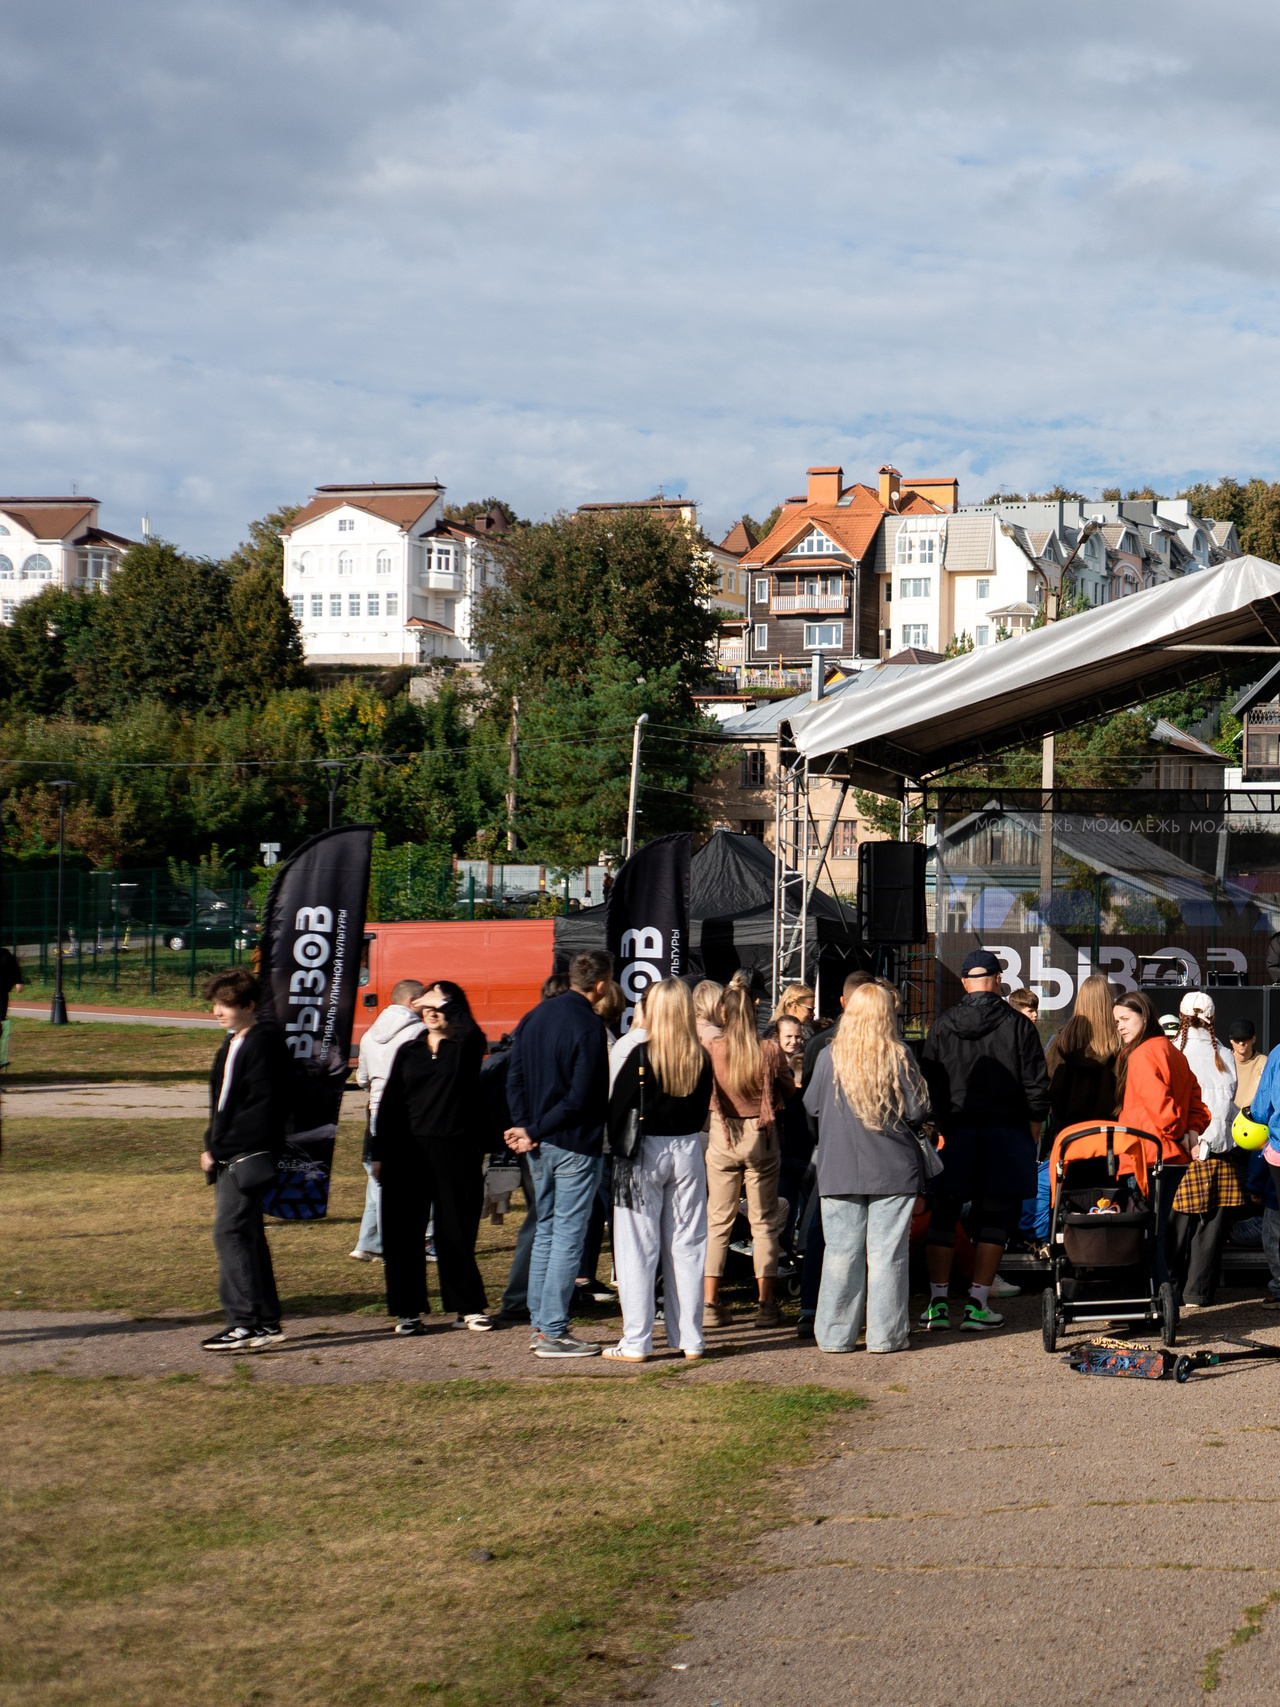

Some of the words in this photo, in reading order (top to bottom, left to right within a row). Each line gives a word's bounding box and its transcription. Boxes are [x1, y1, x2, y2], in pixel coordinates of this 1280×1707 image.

[285, 905, 334, 1059] ВЫЗОВ
[319, 1006, 339, 1061] ФЕСТИВАЛЬ
[329, 960, 345, 1006] УЛИЧНОЙ
[337, 909, 349, 959] КУЛЬТУРЫ
[670, 929, 680, 977] ЛЬТУРЫ
